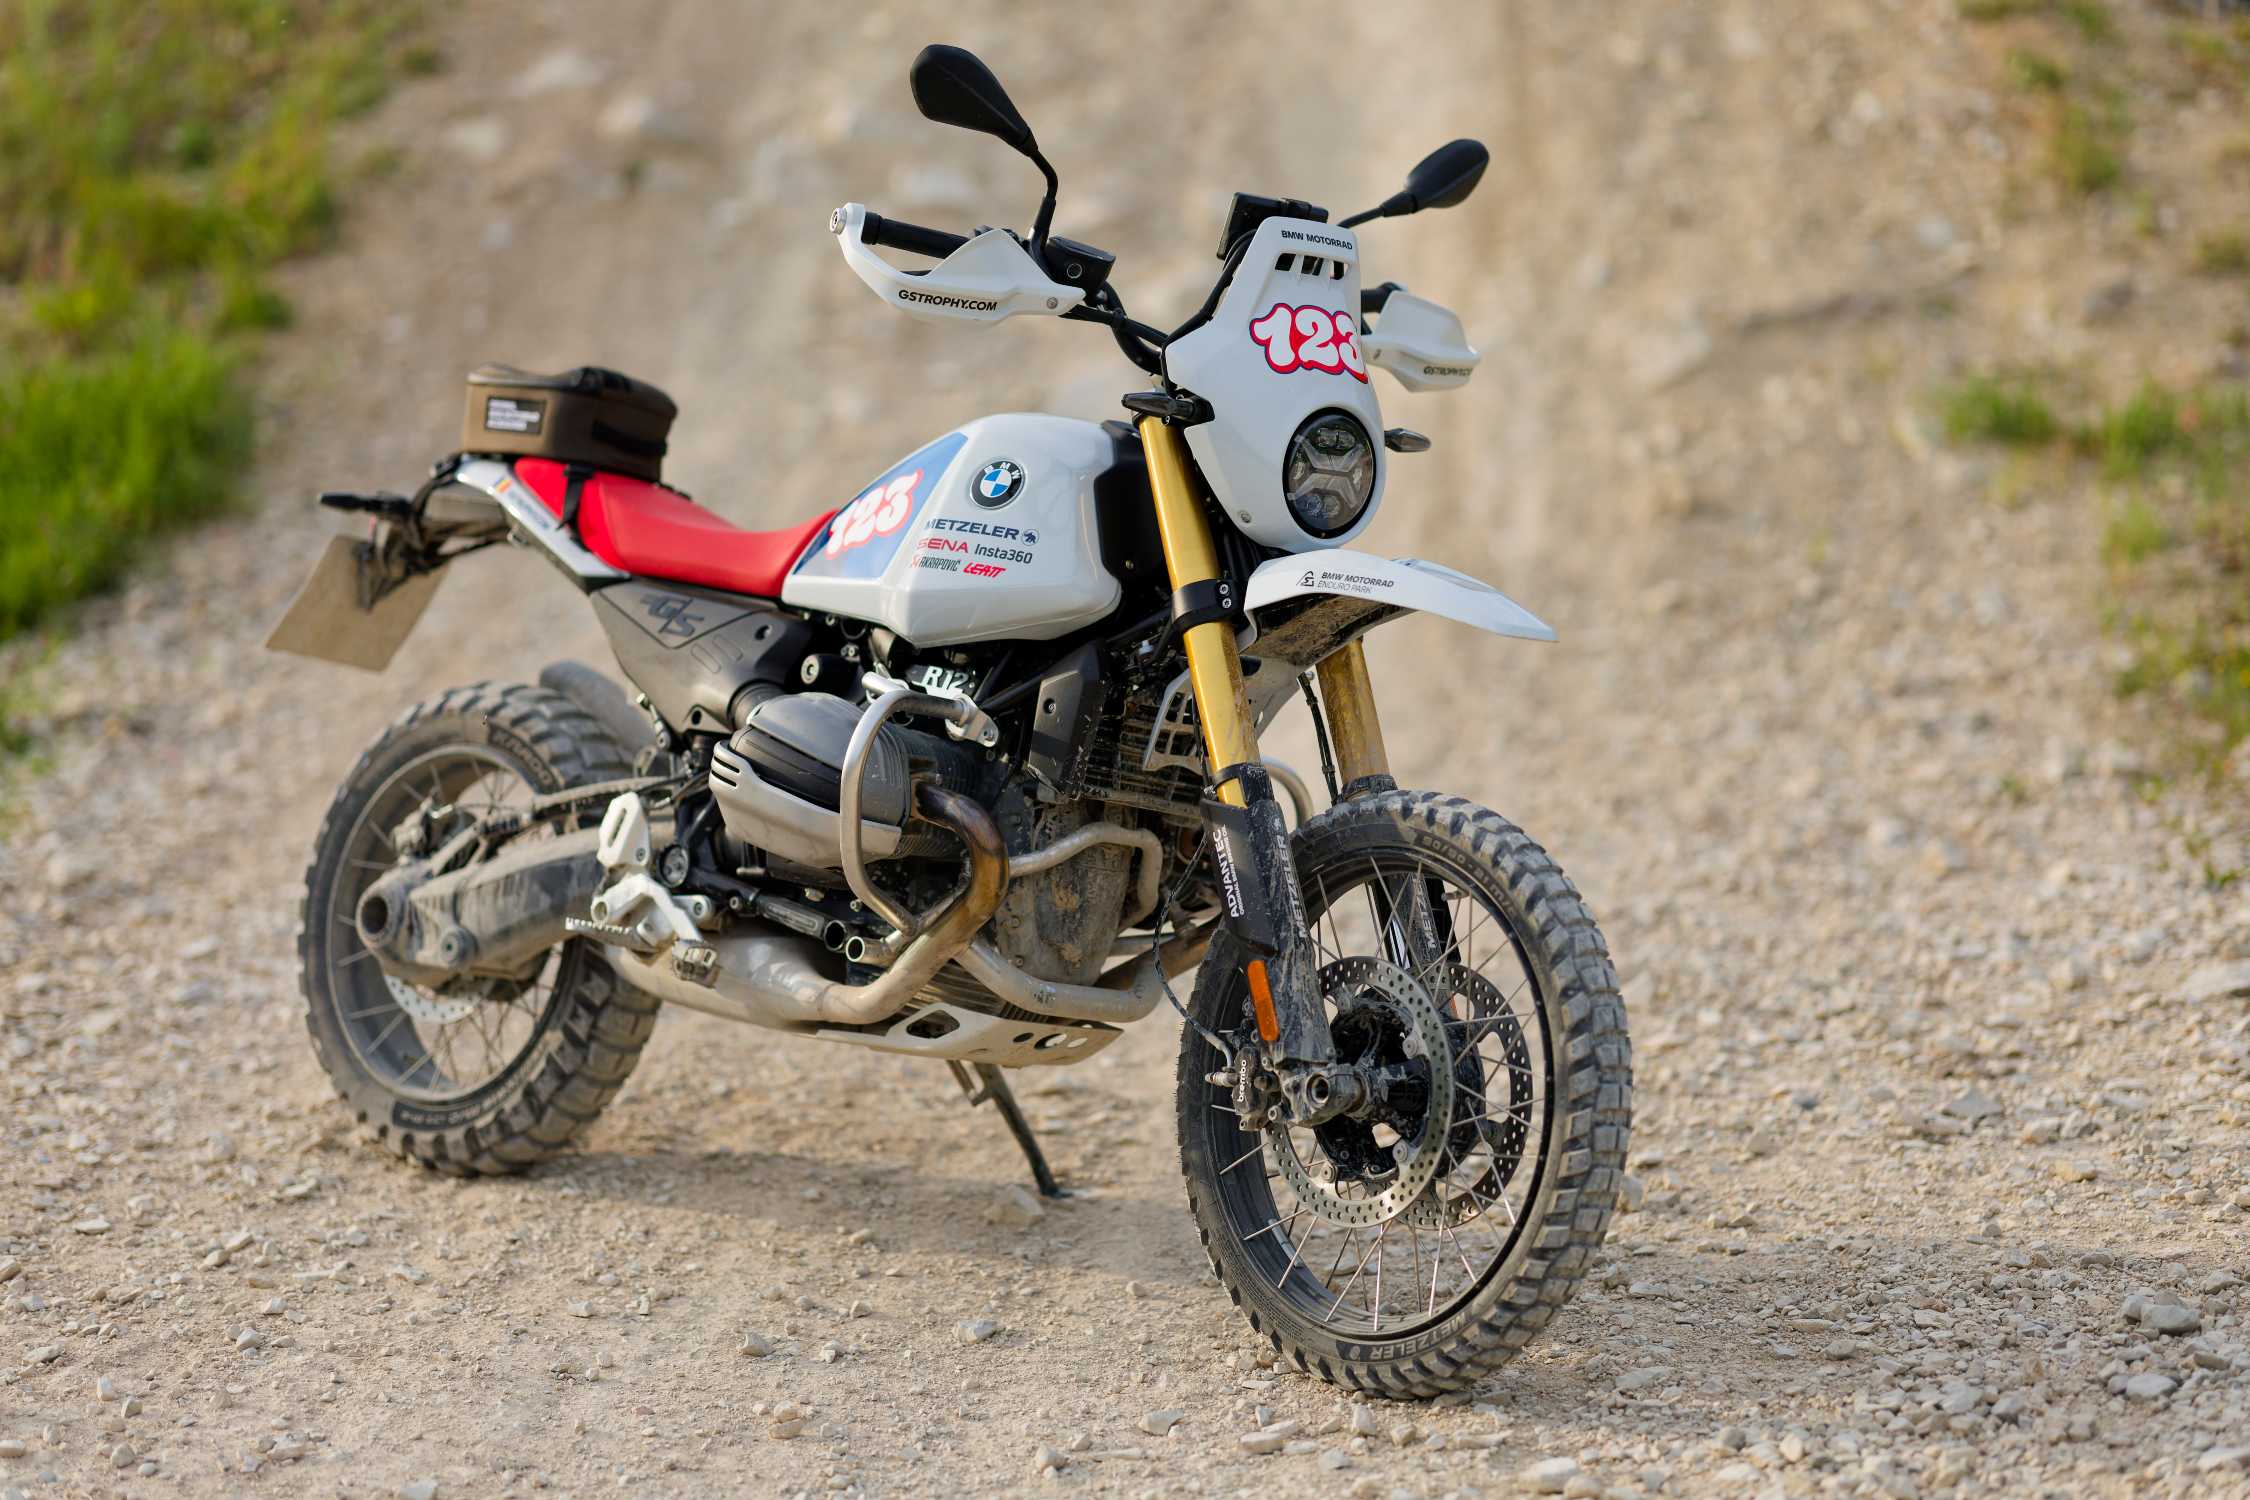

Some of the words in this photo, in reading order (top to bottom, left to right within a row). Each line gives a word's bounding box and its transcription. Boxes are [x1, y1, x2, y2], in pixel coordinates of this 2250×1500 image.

[1281, 230, 1304, 241] BMW
[1306, 233, 1353, 250] MOTORRAD
[898, 289, 998, 312] GSTROPHY.COM
[1249, 303, 1368, 384] 123
[983, 461, 1021, 480] BMW
[826, 469, 924, 560] 123
[926, 518, 1020, 541] METZELER
[917, 537, 969, 554] SENA
[974, 543, 1034, 565] Insta360
[962, 562, 1007, 578] LEATT
[1321, 571, 1344, 581] BMW
[1344, 574, 1395, 588] MOTORRAD
[1212, 828, 1240, 918] ADVANTEC
[1276, 834, 1307, 938] METZELER
[1236, 1059, 1247, 1102] brembo
[1369, 1311, 1467, 1360] METZELER
